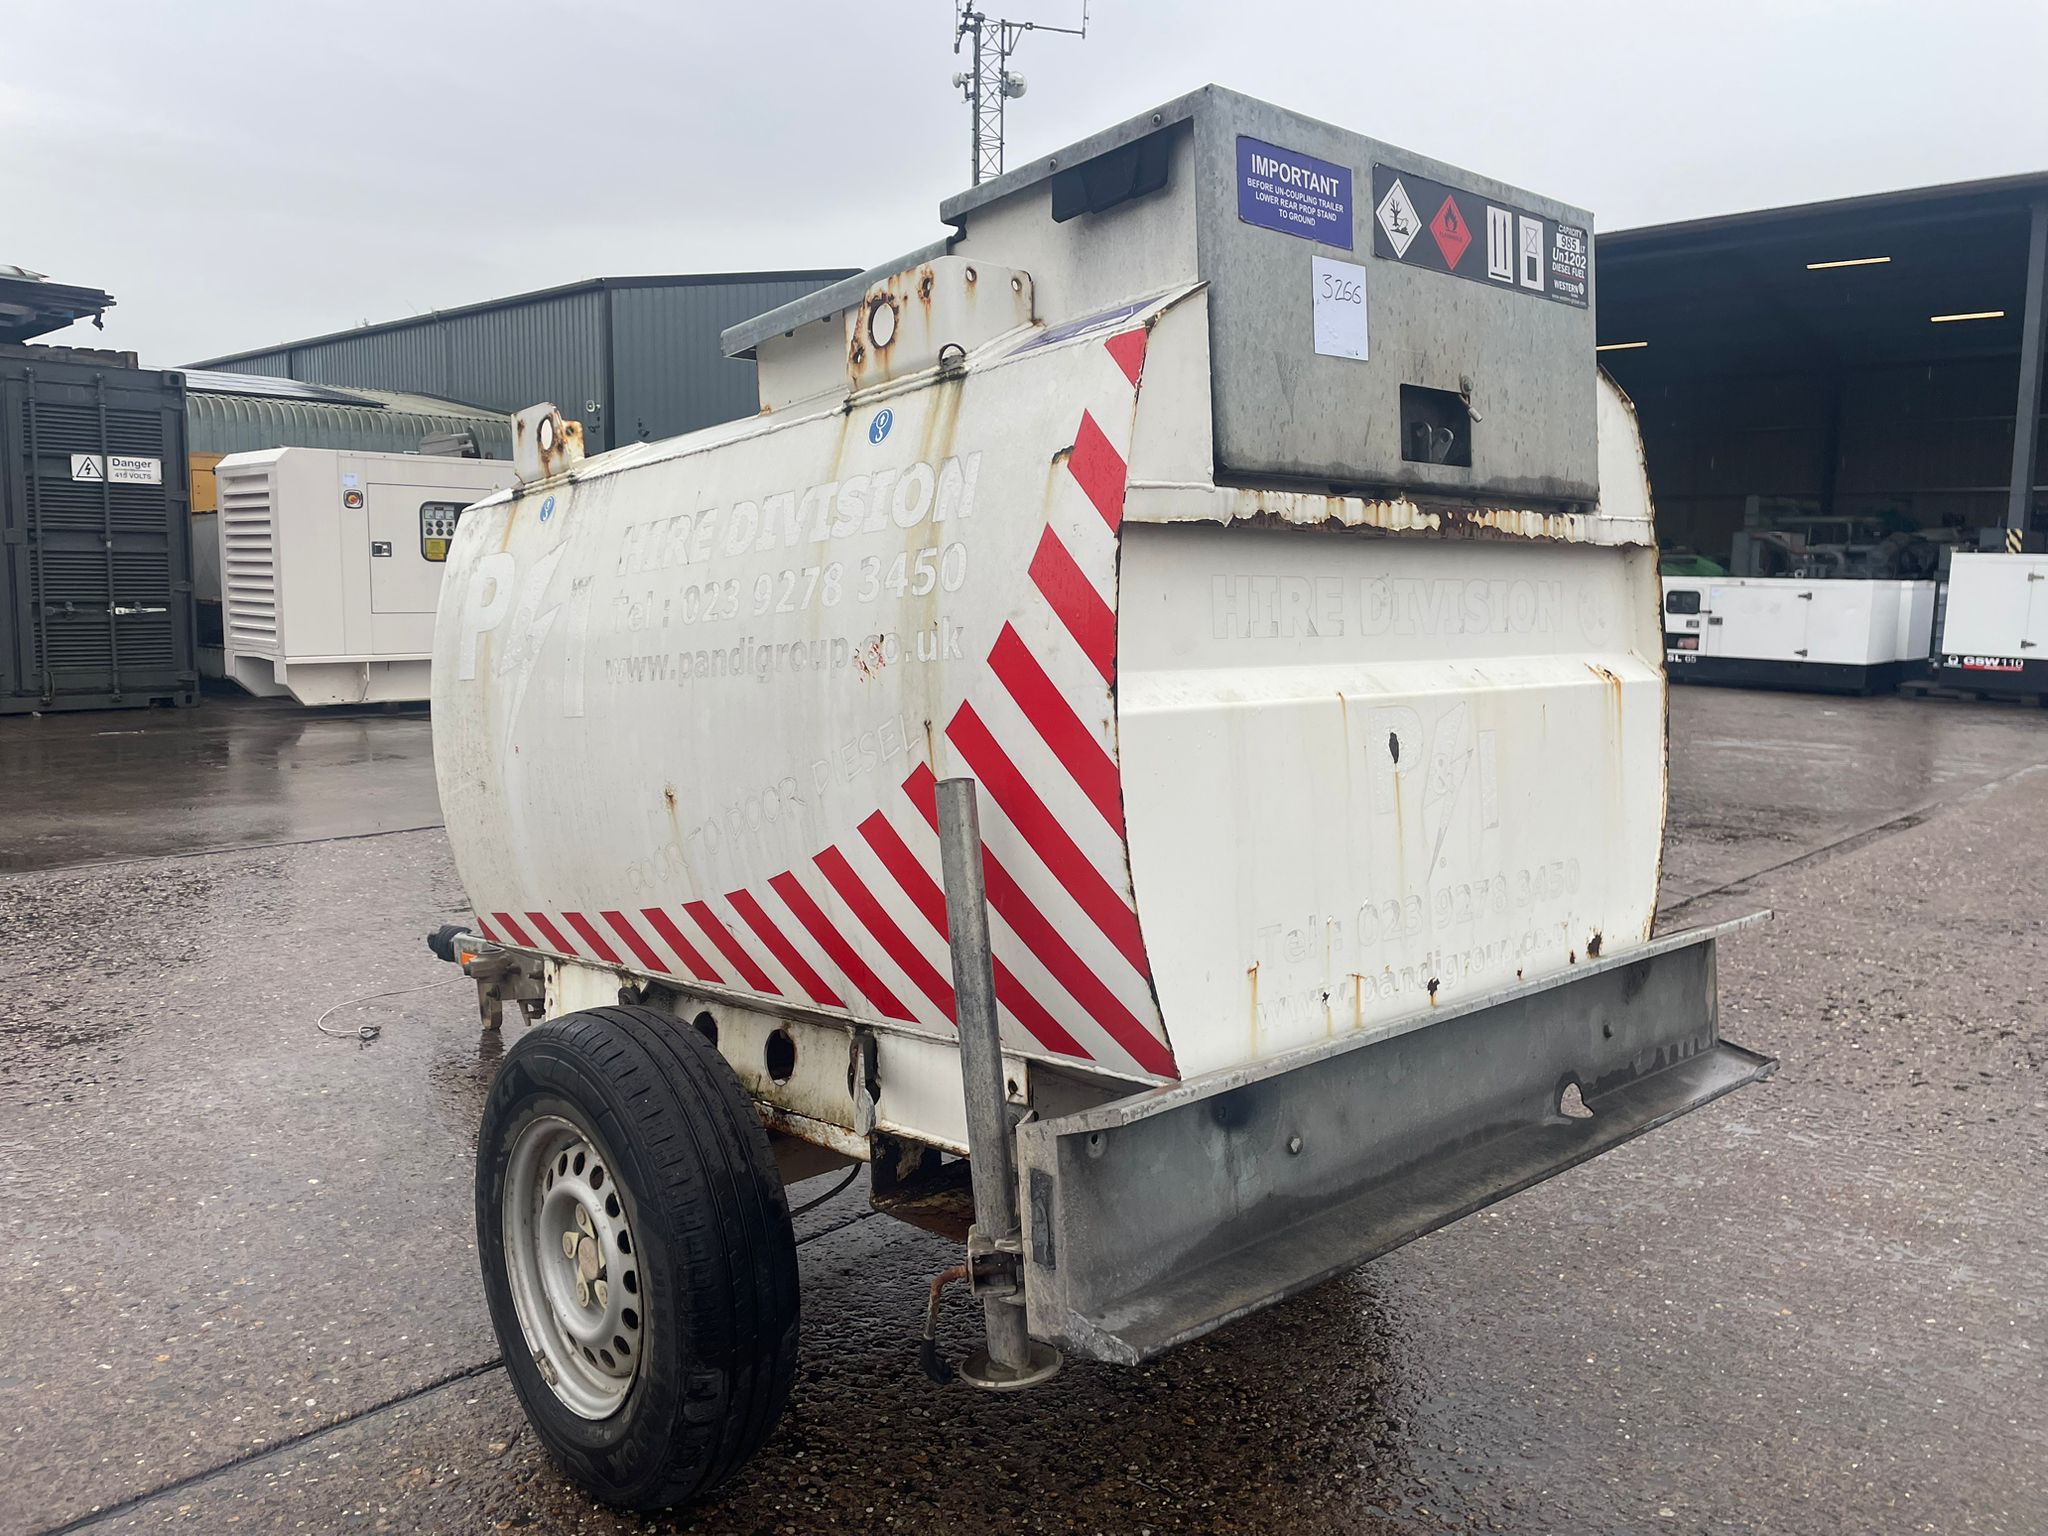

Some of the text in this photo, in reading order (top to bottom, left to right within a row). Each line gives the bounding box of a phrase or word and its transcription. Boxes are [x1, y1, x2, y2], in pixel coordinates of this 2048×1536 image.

[1251, 153, 1339, 198] IMPORTANT
[1247, 177, 1344, 213] BEFORE UN-COUPLING TRAILER
[1255, 191, 1337, 222] LOWER REAR PROP STAND
[1279, 208, 1316, 226] TO GROUND
[1558, 224, 1583, 239] CAPACITY
[1552, 247, 1587, 269] Un1202
[1561, 236, 1577, 251] 985
[1552, 261, 1585, 279] DIESEL FUEL
[1321, 273, 1362, 305] 3266
[1553, 279, 1579, 294] WESTERN
[112, 457, 152, 469] Danger
[129, 472, 152, 480] VOLTS
[615, 450, 984, 577] HIRE DIVISION
[681, 578, 741, 627] 023
[752, 560, 847, 618] 9278
[856, 541, 969, 604] 3450
[1210, 574, 1564, 640] HIRE DIVISION
[604, 615, 965, 688] www.pandigroup.co.uk
[2001, 658, 2024, 669] 110
[811, 713, 922, 796] DIESEL
[1357, 892, 1425, 948] 023
[1434, 871, 1509, 931] 9278
[1515, 856, 1582, 909] 3450
